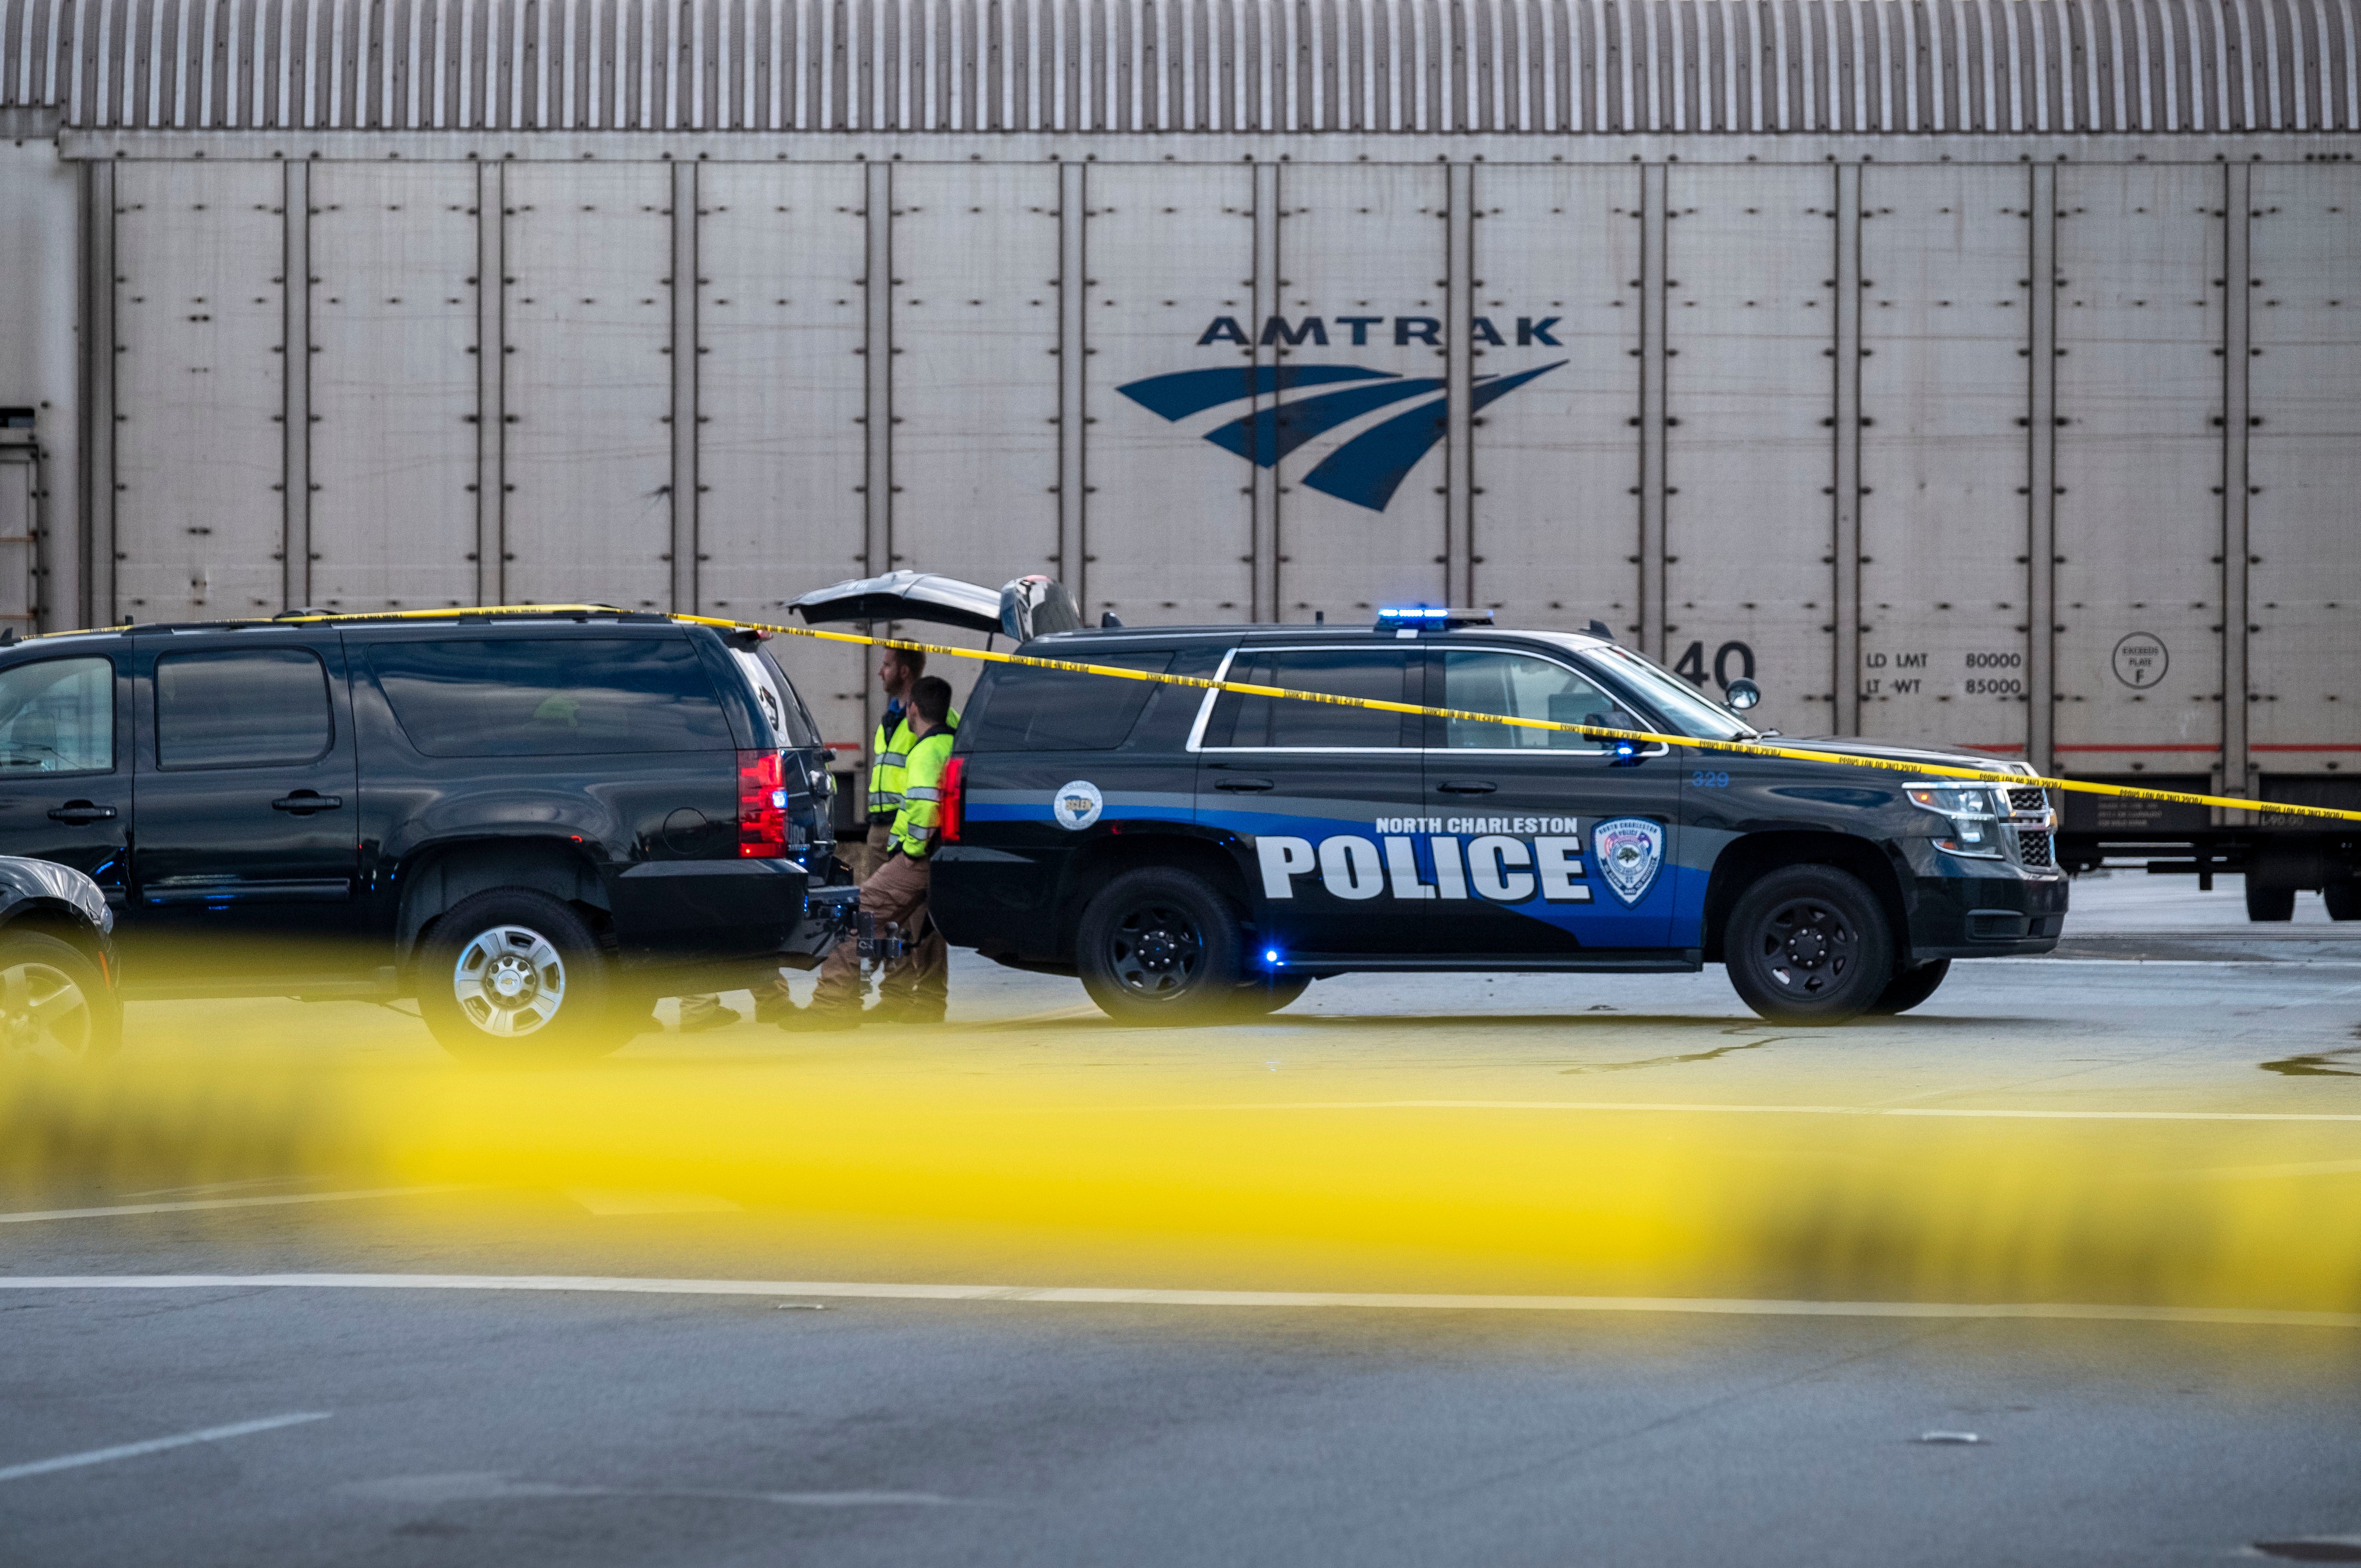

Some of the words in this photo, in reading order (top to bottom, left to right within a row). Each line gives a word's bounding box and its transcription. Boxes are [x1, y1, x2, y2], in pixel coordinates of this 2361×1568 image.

[1196, 316, 1564, 346] AMTRAK
[2122, 646, 2159, 655] EXCEEDS
[1673, 640, 1756, 691] 40
[1867, 653, 1887, 667] LD
[1896, 653, 1928, 667] LMT
[1966, 653, 2021, 668] 80000
[2129, 658, 2151, 666] PLATE
[2136, 669, 2144, 683] F
[1867, 679, 1880, 693] LT
[1966, 679, 2021, 694] 85000
[1692, 771, 1729, 787] 329
[1376, 818, 1441, 833] NORTH
[1446, 818, 1578, 834] CHARLESTON
[1599, 823, 1618, 834] NORTH
[1620, 822, 1658, 833] CHARLESTON
[1255, 835, 1591, 900] POLICE
